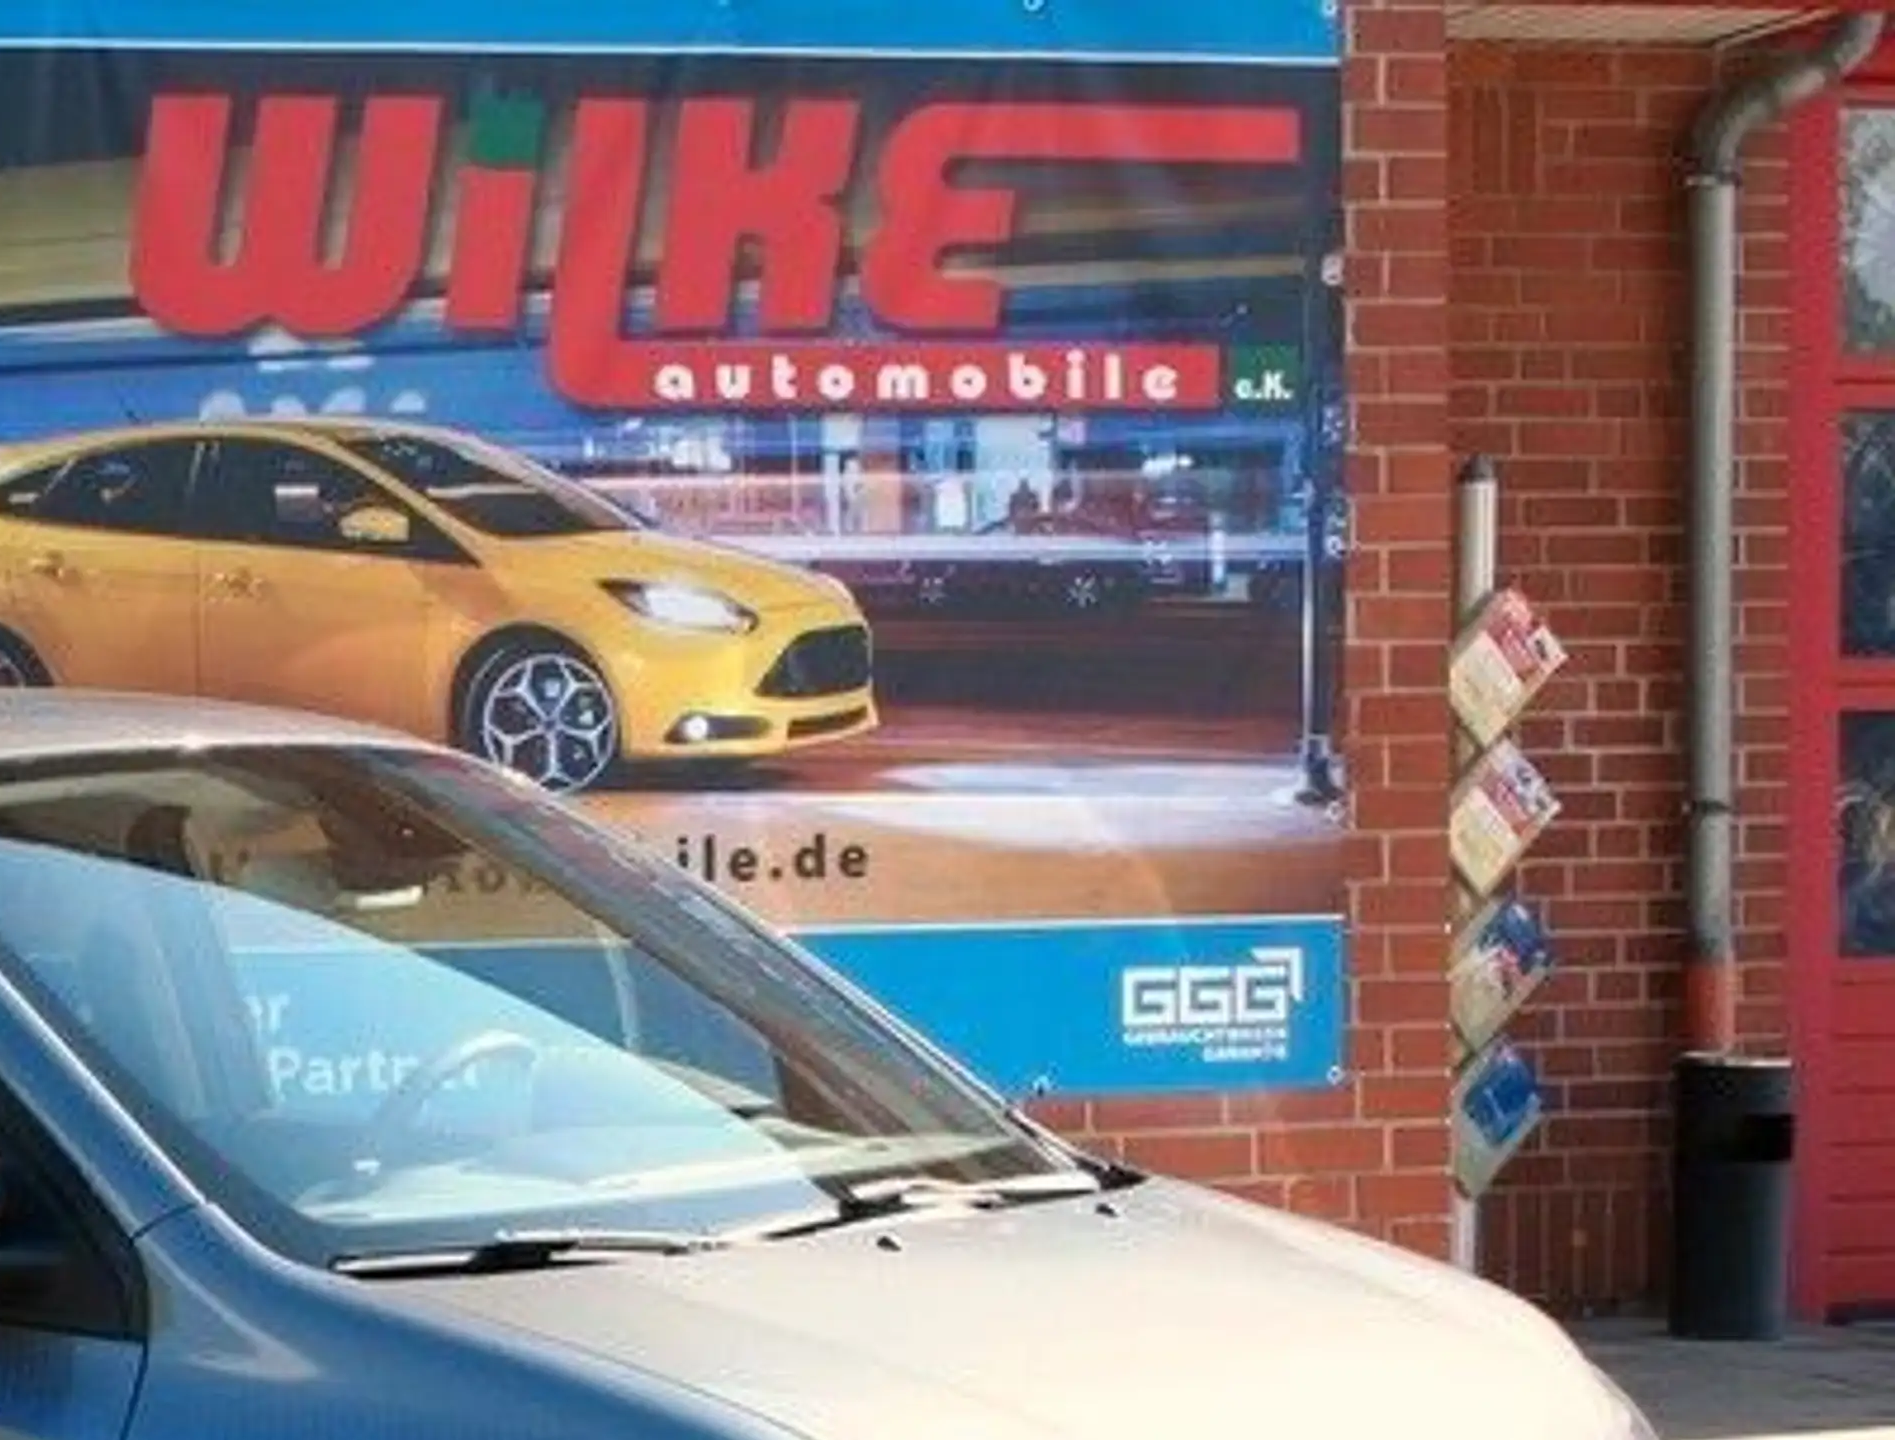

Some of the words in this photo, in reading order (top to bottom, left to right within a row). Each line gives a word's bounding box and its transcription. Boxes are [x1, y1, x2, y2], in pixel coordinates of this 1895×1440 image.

[653, 348, 1180, 402] automobile
[675, 832, 869, 883] ile.de
[1122, 963, 1288, 1025] GGG
